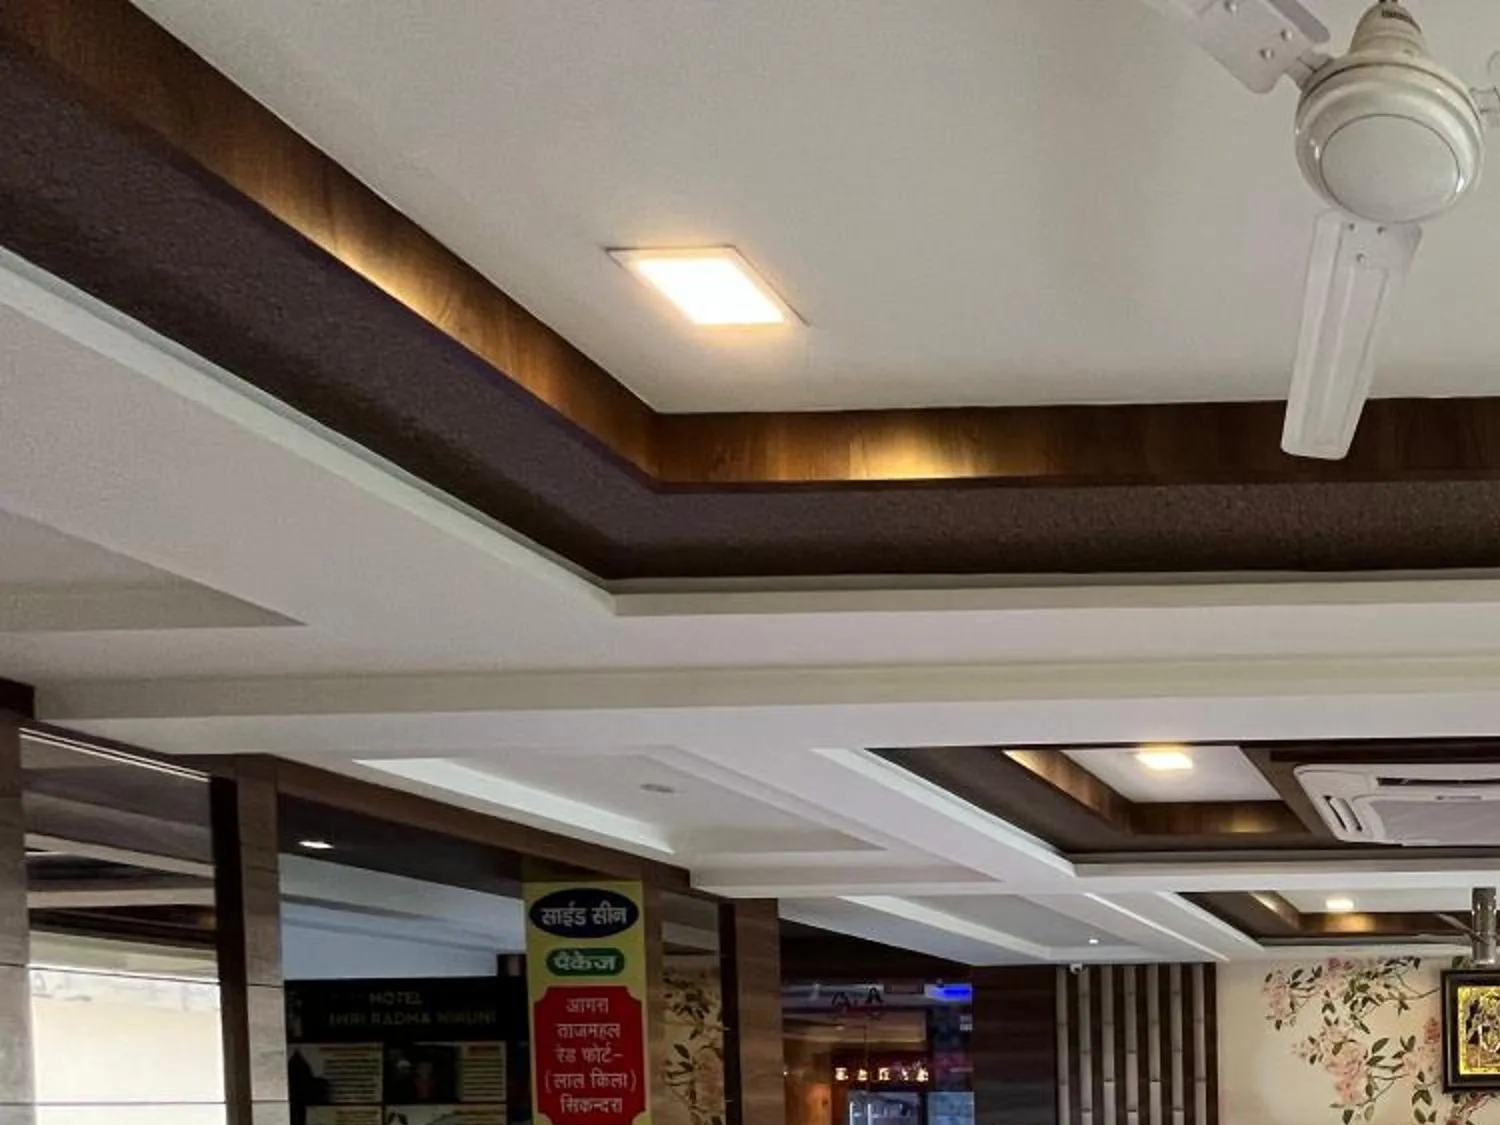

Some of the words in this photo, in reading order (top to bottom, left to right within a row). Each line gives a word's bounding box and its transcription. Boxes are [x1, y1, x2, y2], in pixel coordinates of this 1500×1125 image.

[541, 900, 587, 928] साईड
[591, 900, 627, 925] सीन
[553, 950, 617, 971] पैकेज
[368, 990, 424, 1005] HOTEL
[566, 997, 609, 1014] आगरा
[371, 1010, 432, 1026] RADHA
[556, 1023, 621, 1039] ताजमहल
